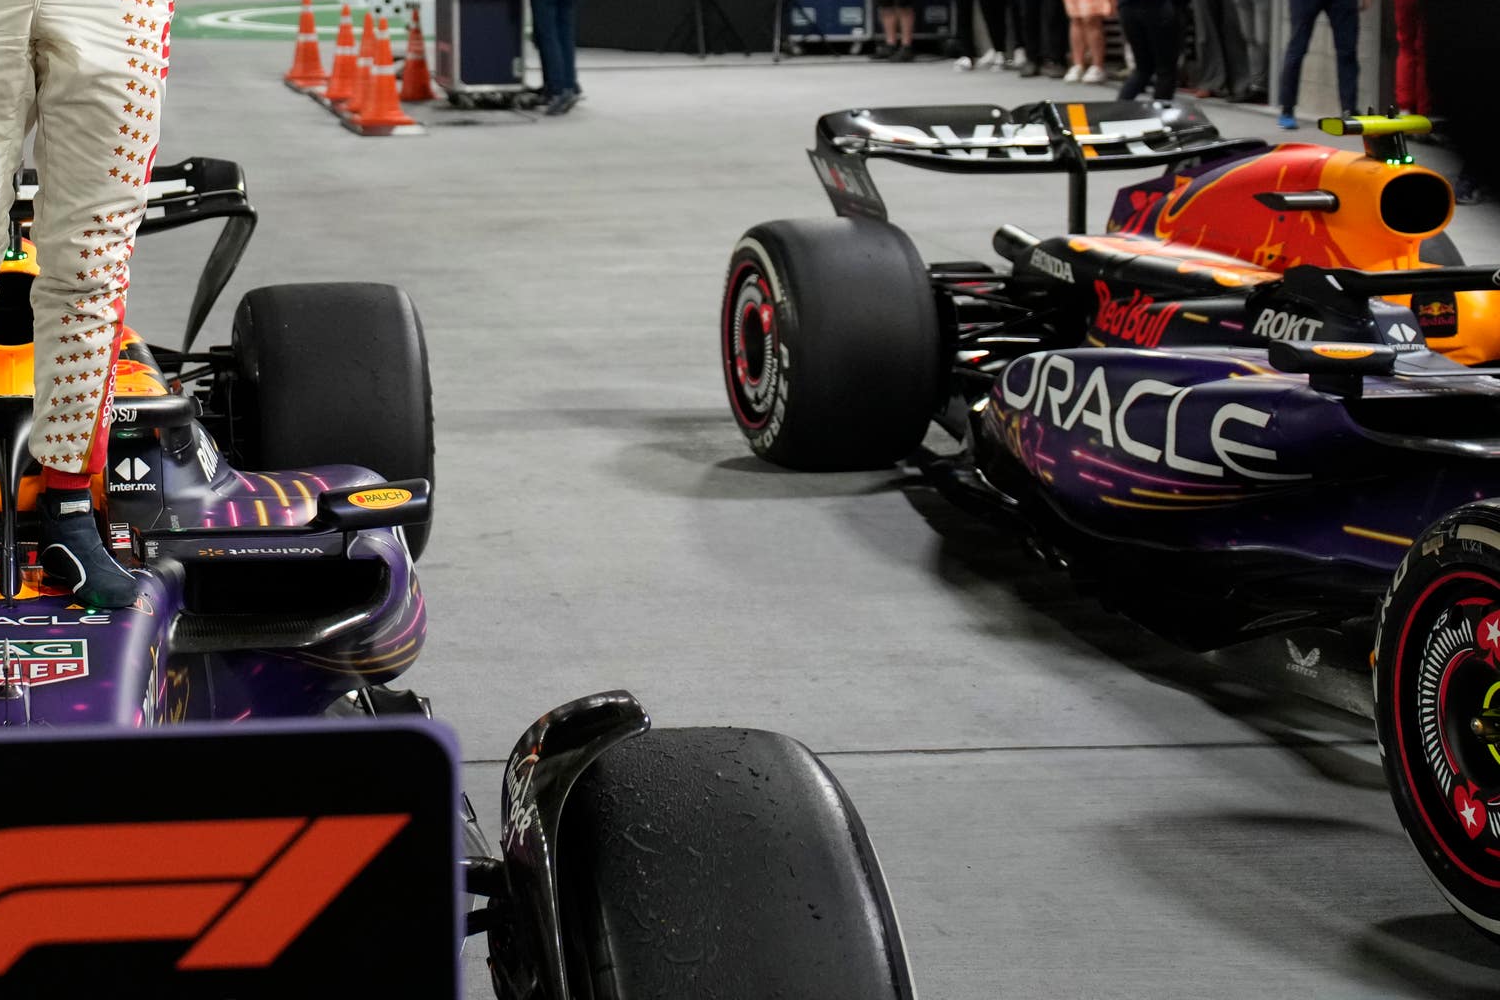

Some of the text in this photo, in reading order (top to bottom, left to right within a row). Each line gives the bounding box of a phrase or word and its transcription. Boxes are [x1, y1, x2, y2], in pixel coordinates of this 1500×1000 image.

[1030, 248, 1075, 284] HONDA
[1252, 308, 1324, 341] ROKT
[1002, 351, 1313, 481] ORACLE
[110, 482, 157, 492] inter.mx
[366, 490, 405, 503] RAUCH
[228, 547, 324, 556] Walmart
